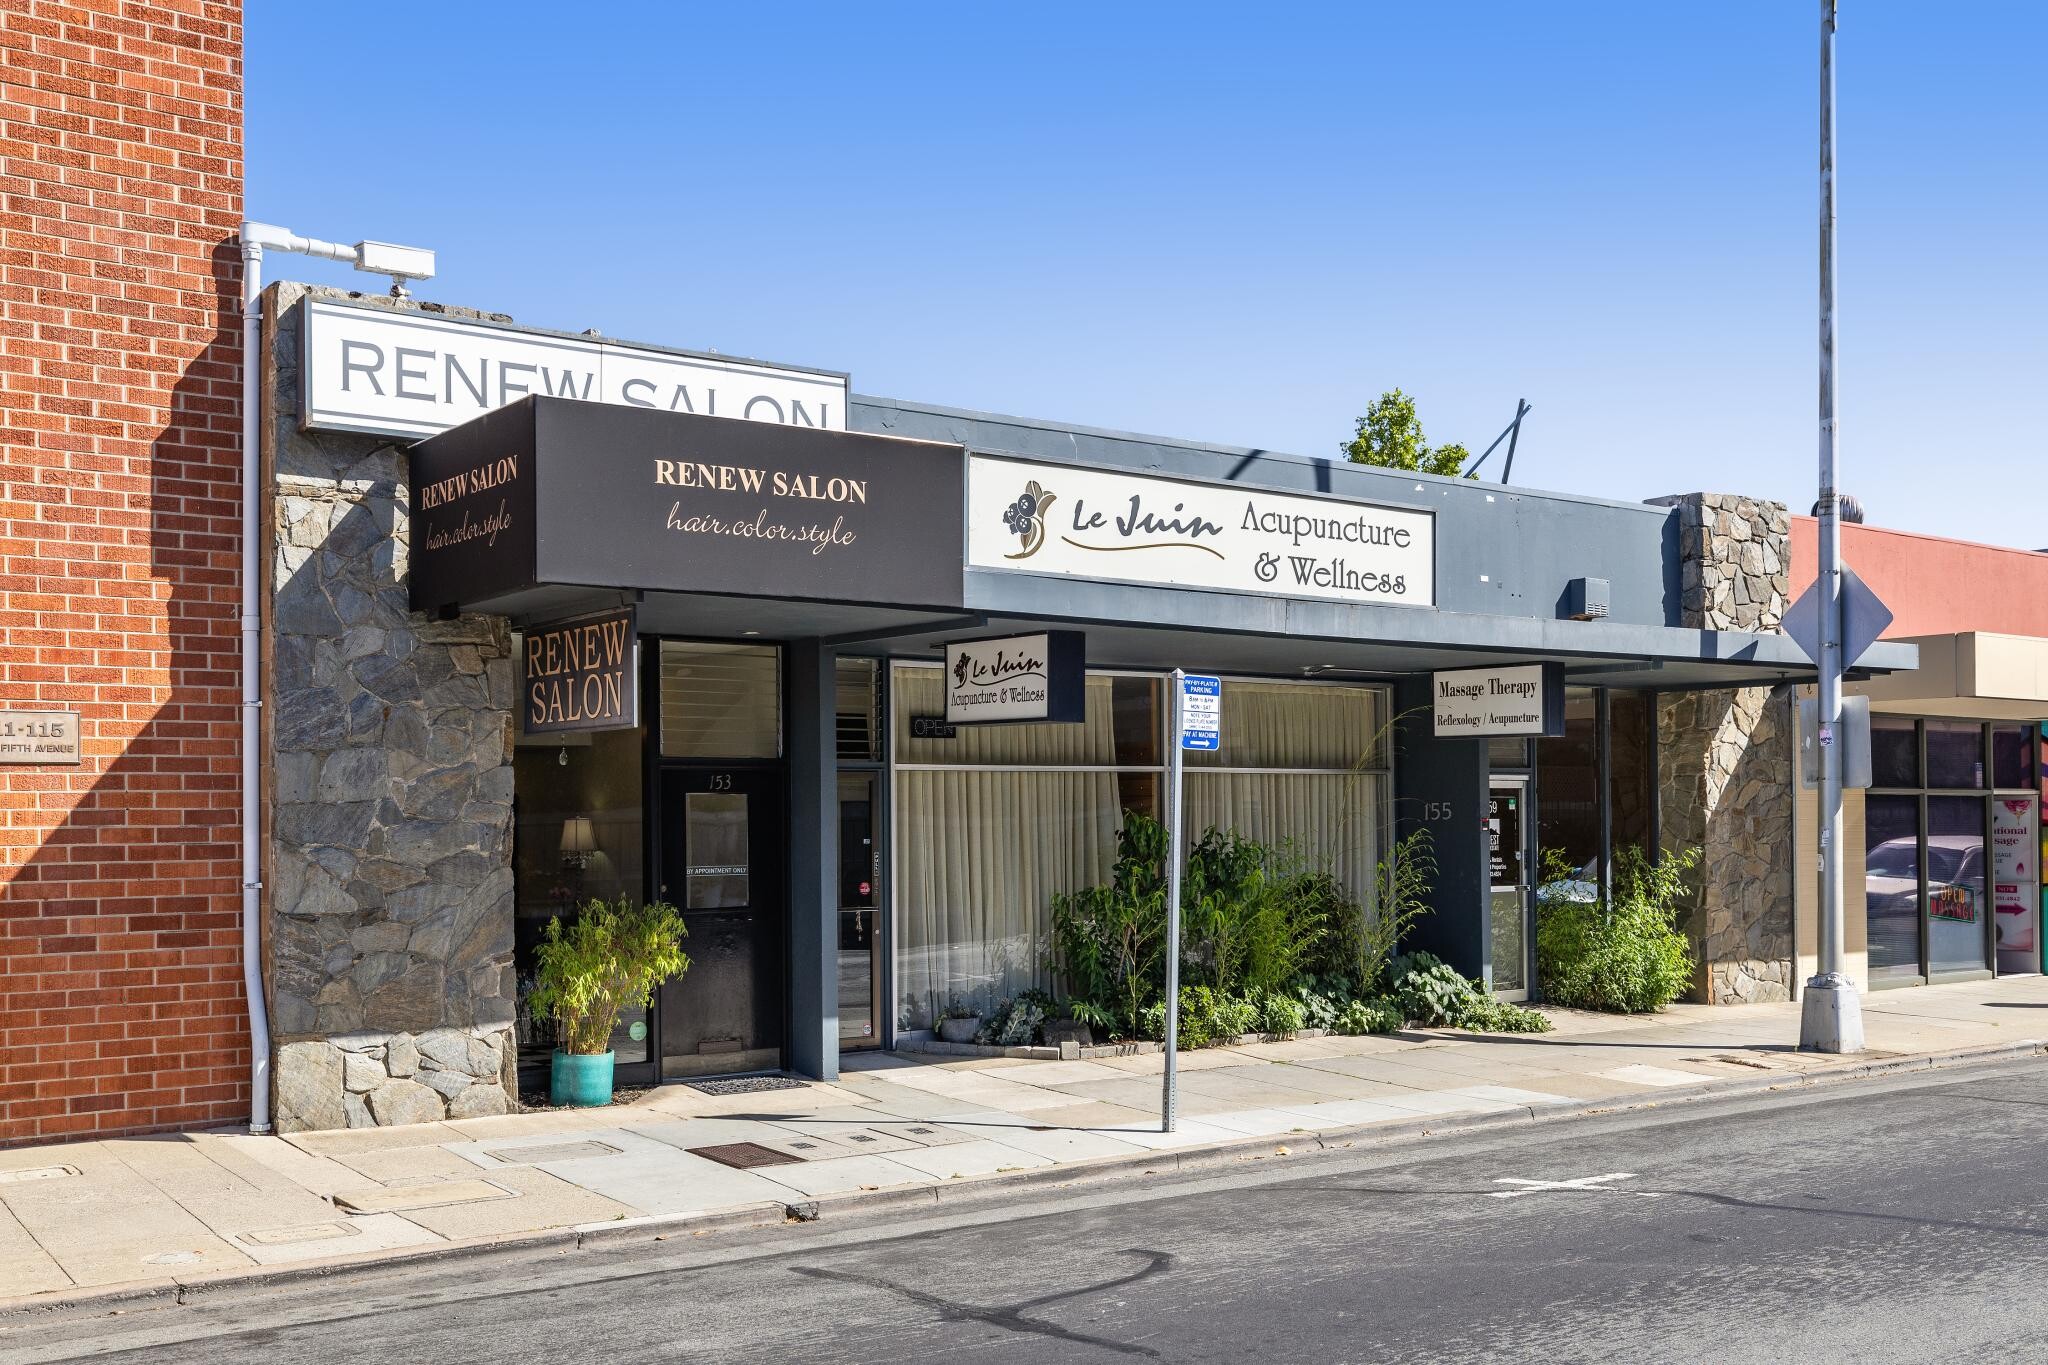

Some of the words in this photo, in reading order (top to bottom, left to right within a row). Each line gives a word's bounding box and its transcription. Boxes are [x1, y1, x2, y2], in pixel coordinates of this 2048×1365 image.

[340, 339, 594, 408] RENEW
[422, 473, 468, 510] RENEW
[471, 455, 517, 494] SALON
[654, 459, 765, 494] RENEW
[773, 472, 867, 504] SALON
[426, 498, 512, 550] hair.color.style
[667, 501, 856, 555] hair.color.style
[1072, 499, 1107, 530] Le
[1116, 494, 1223, 537] Juin
[1241, 501, 1411, 549] Acupuncture
[1254, 552, 1280, 582] &
[1288, 555, 1406, 594] Wellness
[527, 619, 628, 678] RENEW
[973, 660, 988, 678] Le
[991, 651, 1043, 676] Juin
[532, 671, 623, 724] SALON
[951, 688, 997, 710] Acupuncture
[1001, 689, 1007, 704] &
[1009, 686, 1044, 703] Wellness
[1439, 681, 1484, 700] Massage
[1488, 678, 1537, 698] Therapy
[1437, 713, 1481, 727] Reflexology
[1489, 712, 1539, 726] Acupuncture
[1, 744, 31, 752] FIFTH
[35, 744, 74, 753] AVENUE
[709, 774, 731, 790] 153
[1424, 802, 1452, 820] 155
[1941, 886, 1965, 904] OPEN
